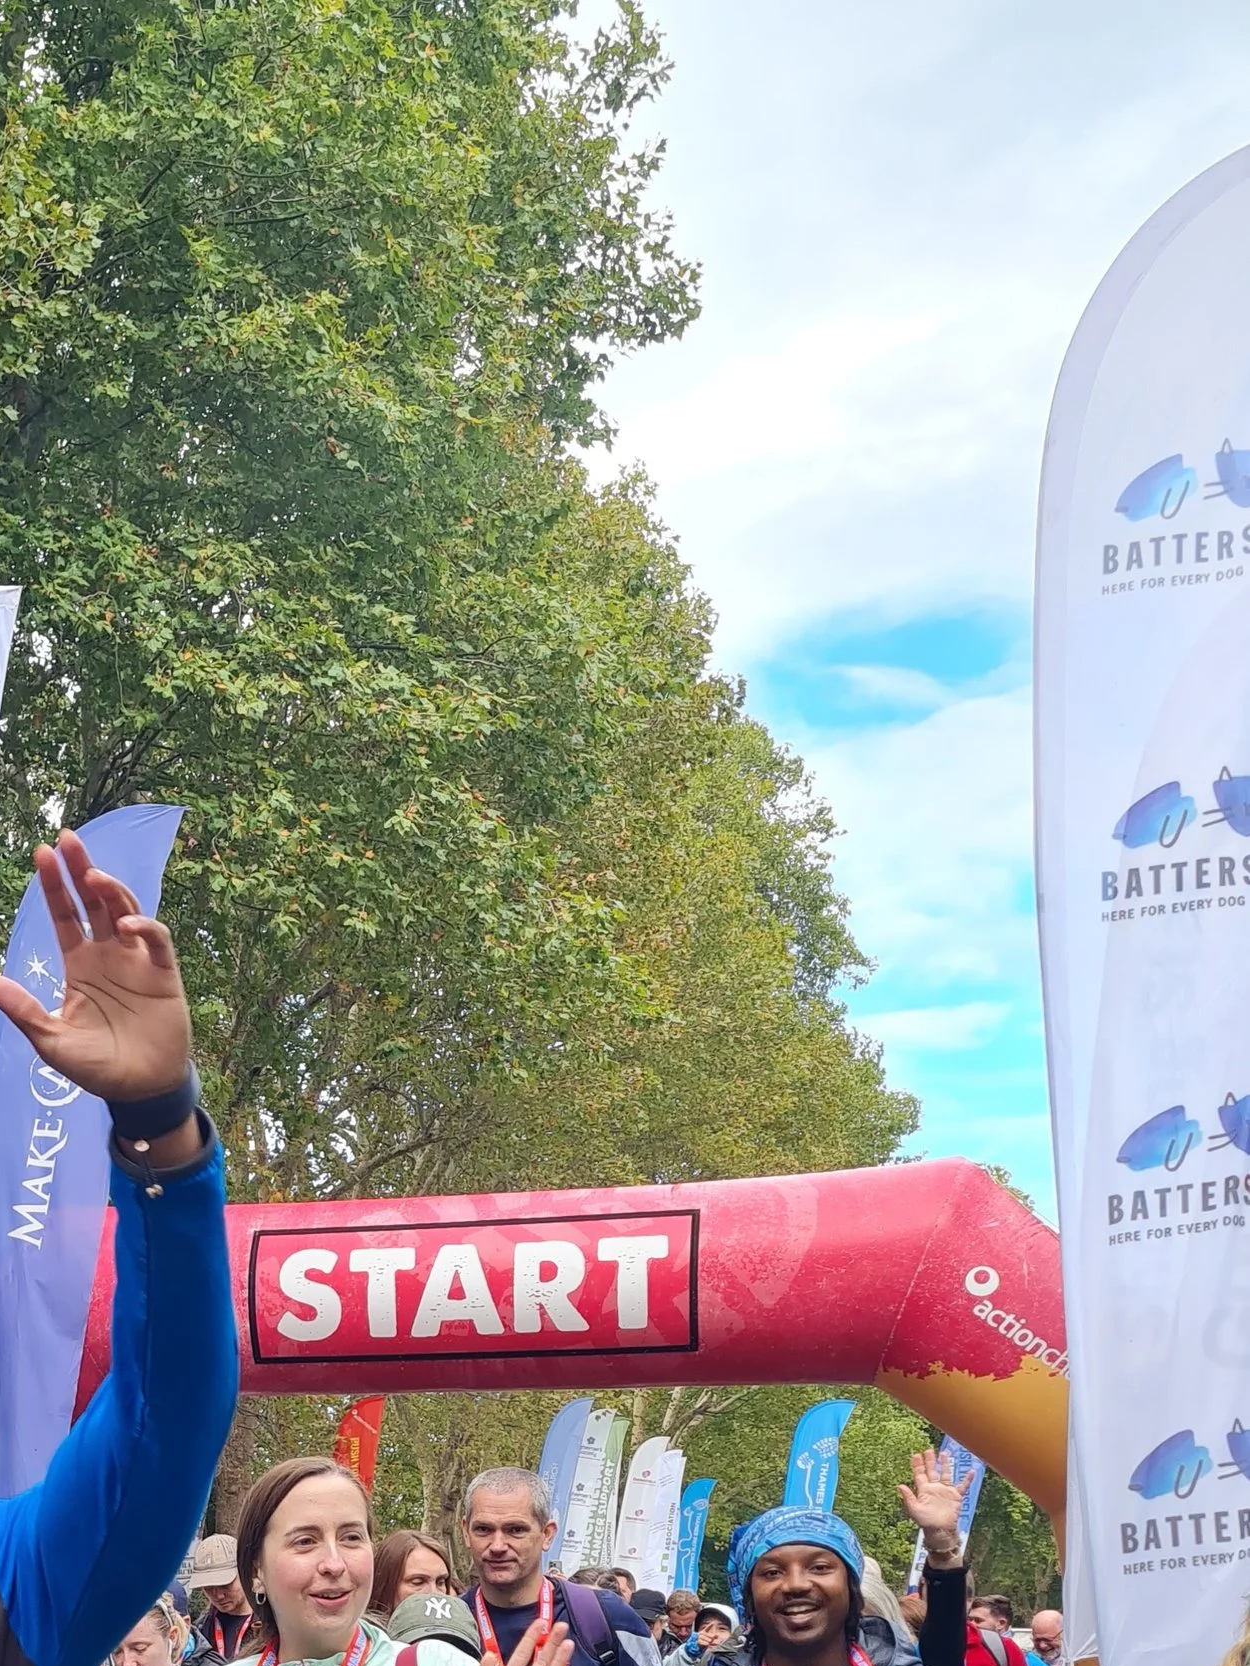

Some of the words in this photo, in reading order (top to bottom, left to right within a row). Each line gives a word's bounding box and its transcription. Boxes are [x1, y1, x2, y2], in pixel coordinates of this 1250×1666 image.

[1101, 580, 1135, 596] HERE
[1141, 576, 1166, 590] FOR
[1171, 572, 1211, 587] EVERY
[1215, 565, 1245, 582] DOG
[1101, 908, 1136, 922] HERE
[1140, 904, 1167, 917] FOR
[1171, 898, 1213, 914] EVERY
[1217, 895, 1246, 908] DOG
[1109, 1230, 1141, 1246] HERE
[1146, 1226, 1172, 1240] FOR
[1177, 1219, 1218, 1235] EVERY
[1223, 1215, 1246, 1227] DOG
[276, 1234, 669, 1343] START
[597, 1458, 616, 1516] SUPPORT
[665, 1502, 676, 1551] ASSOCIATION
[1123, 1561, 1155, 1575] HERE
[1160, 1557, 1187, 1570] FOR
[1192, 1552, 1235, 1567] EVERY
[424, 1597, 452, 1619] NY
